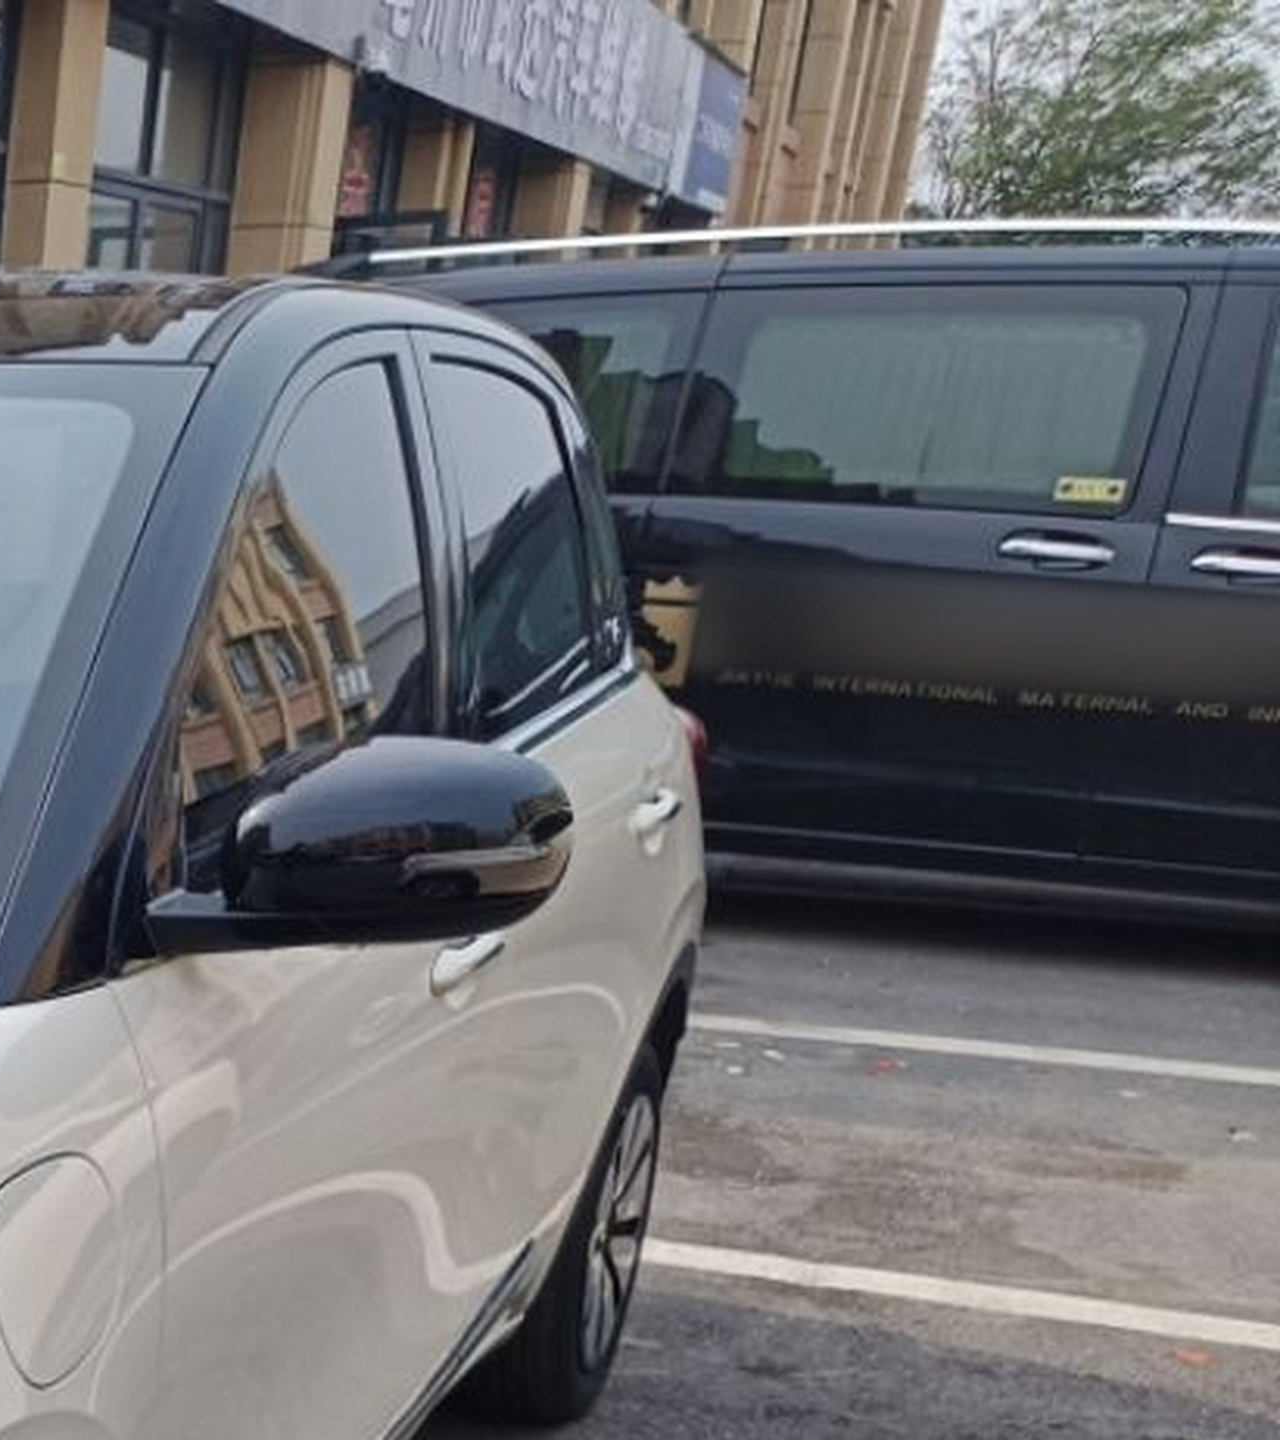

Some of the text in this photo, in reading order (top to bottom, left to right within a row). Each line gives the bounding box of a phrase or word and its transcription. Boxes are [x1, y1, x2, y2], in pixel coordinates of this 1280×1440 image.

[812, 673, 998, 704] INTERNATIONAL
[1019, 690, 1153, 716] MATERNAL
[1176, 702, 1229, 720] AND
